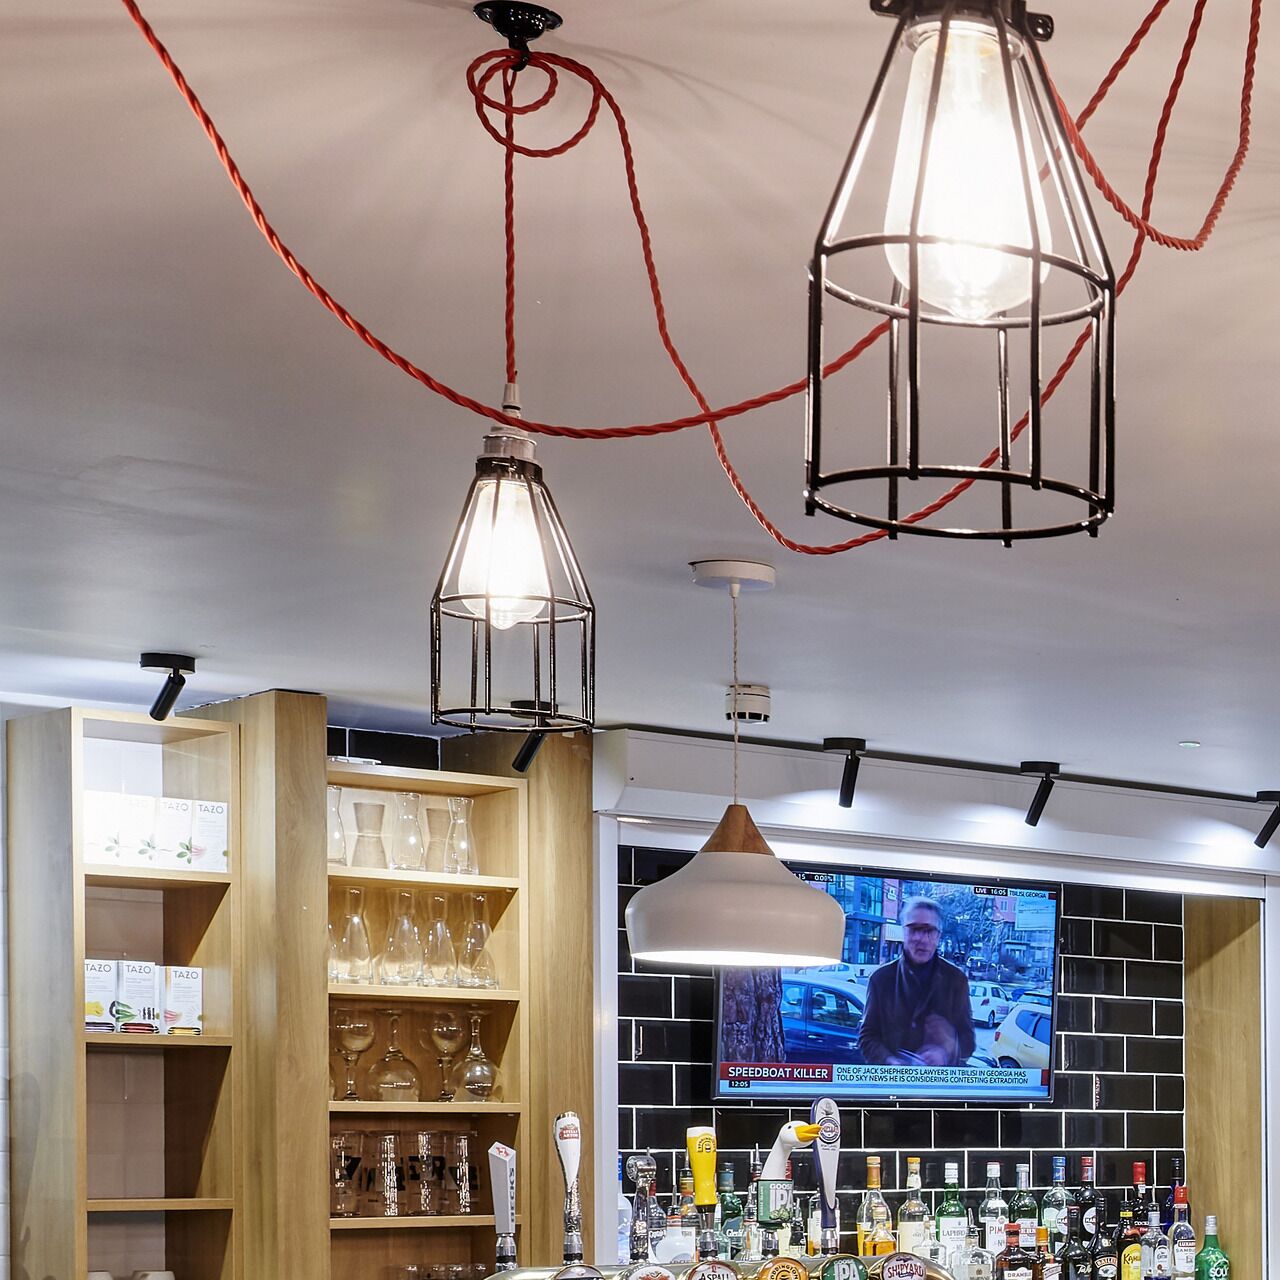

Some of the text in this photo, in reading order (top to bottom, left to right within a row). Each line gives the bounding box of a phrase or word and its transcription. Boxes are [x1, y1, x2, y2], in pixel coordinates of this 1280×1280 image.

[198, 804, 224, 814] TAZO
[991, 888, 1006, 896] 16:05
[85, 964, 112, 973] TAZO
[127, 965, 152, 974] TAZO
[173, 970, 199, 979] TAZO
[728, 1066, 828, 1079] SPEEDBOAT KILLER
[836, 1066, 852, 1074] ONE
[862, 1067, 879, 1075] JACK
[879, 1068, 919, 1076] SHEPHERD'S
[836, 1074, 854, 1082] TOLD
[855, 1074, 868, 1082] SKY
[950, 1076, 989, 1084] CONTESTING
[989, 1077, 1028, 1085] EXTRADITION
[887, 1264, 924, 1279] SHIPYARD
